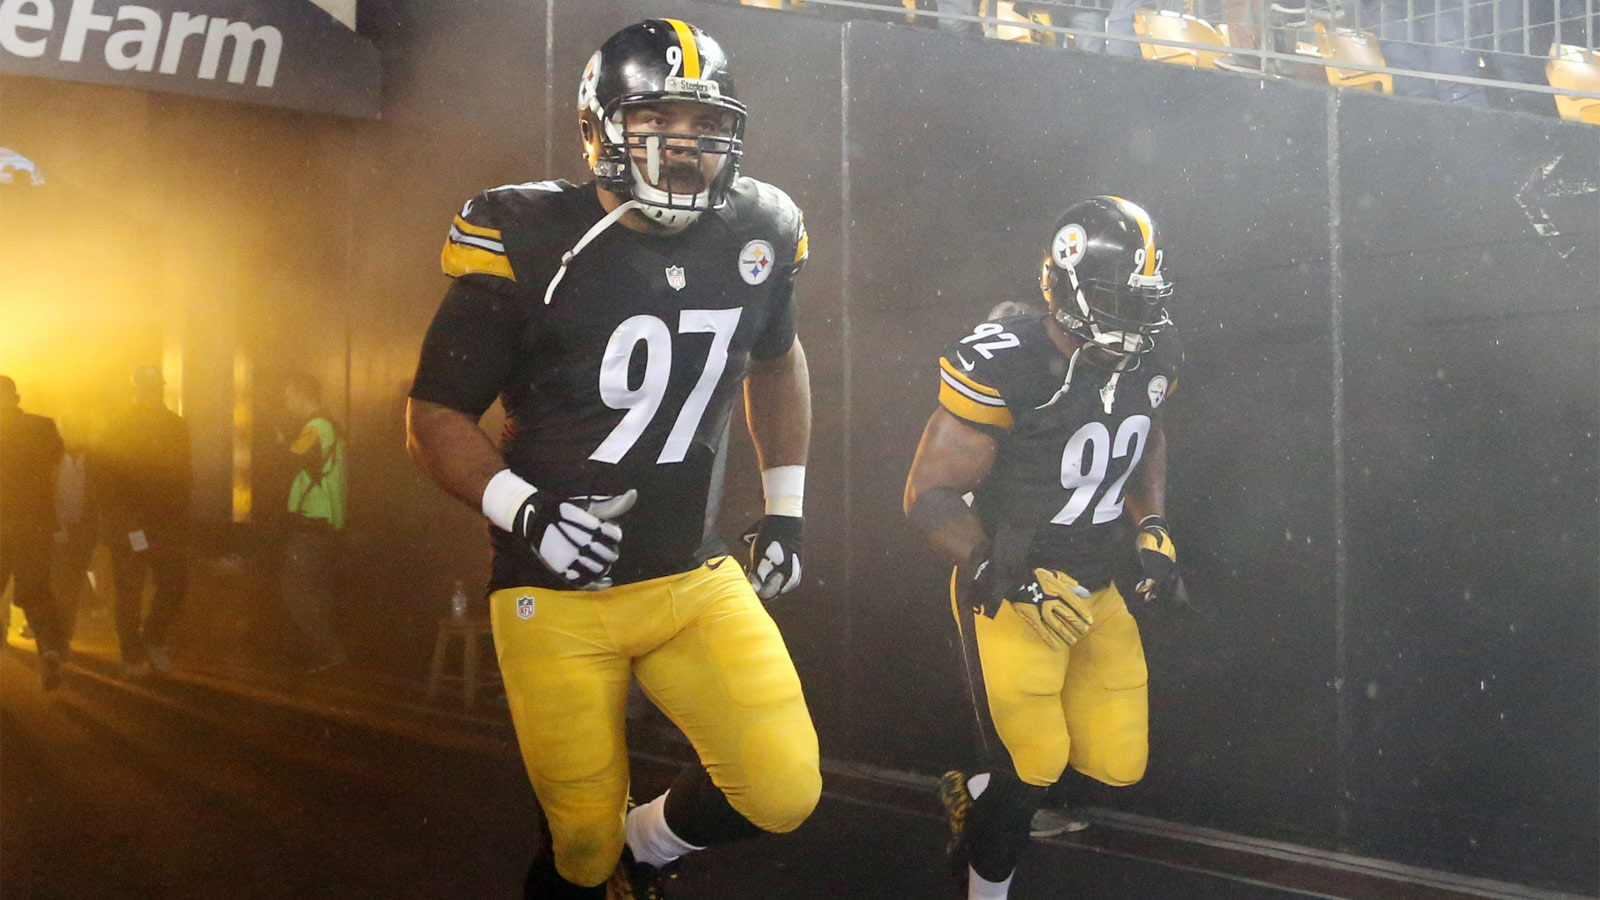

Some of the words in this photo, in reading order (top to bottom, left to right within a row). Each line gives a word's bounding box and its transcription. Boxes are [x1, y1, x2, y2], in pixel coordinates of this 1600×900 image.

[588, 307, 743, 464] 97
[960, 323, 1020, 360] 92
[1050, 415, 1150, 525] 92
